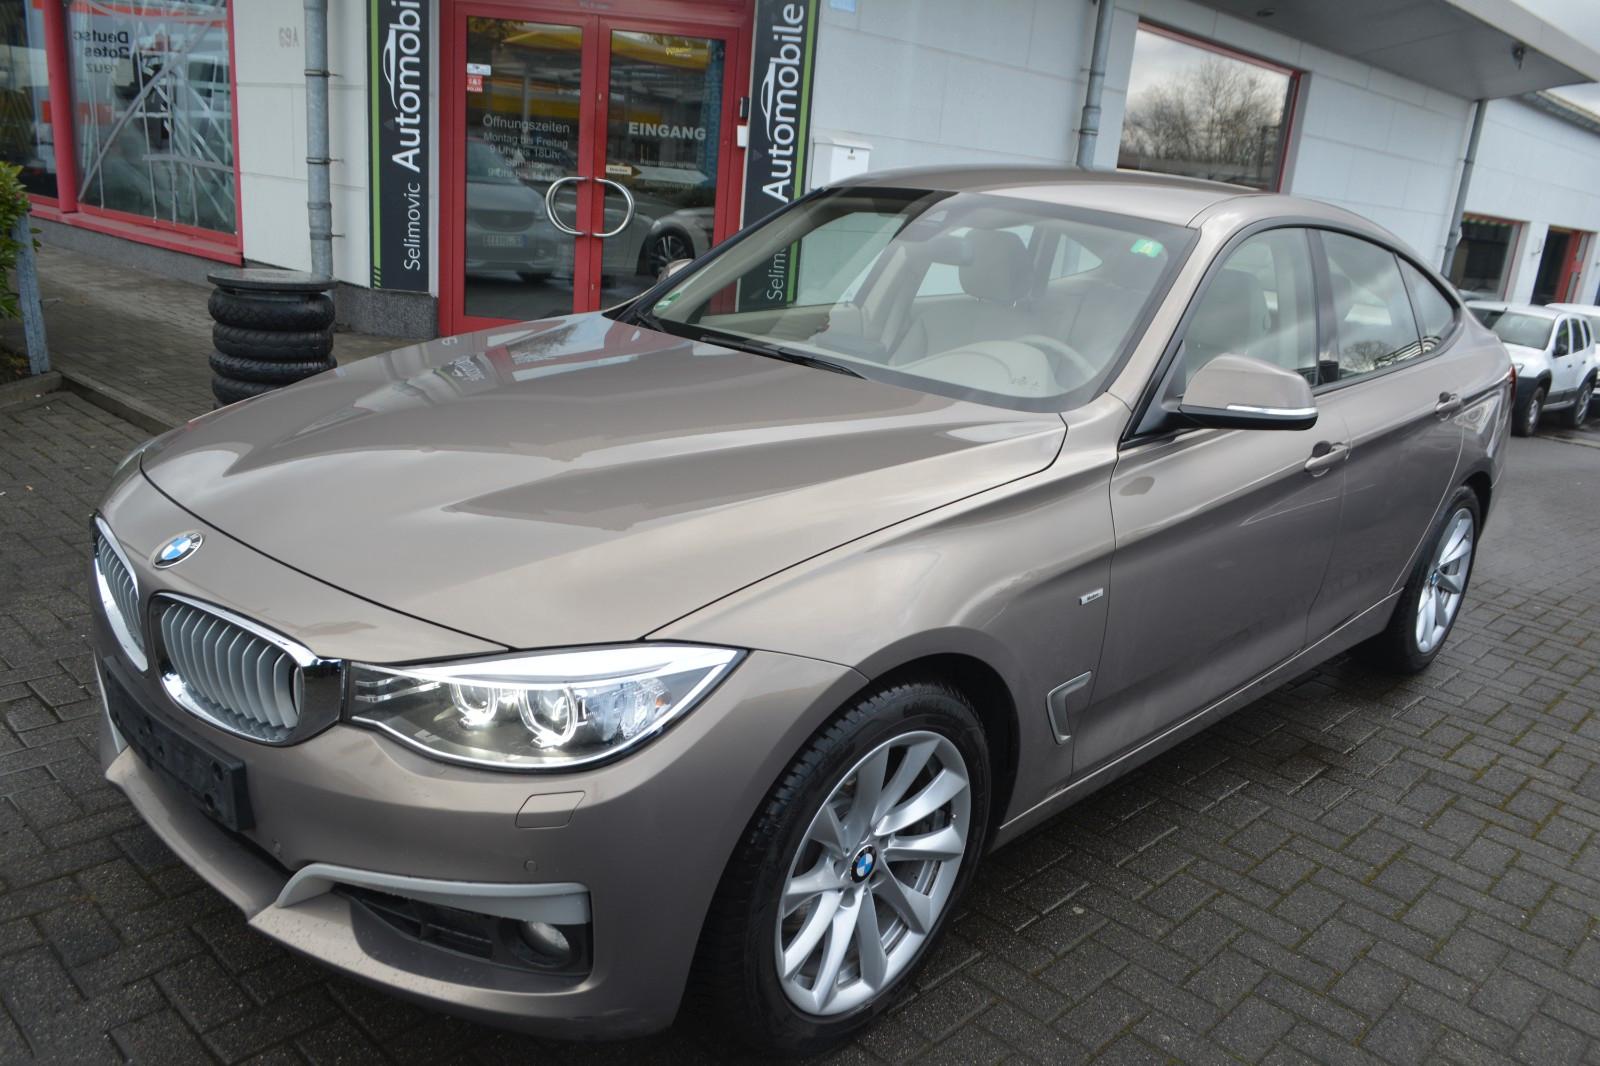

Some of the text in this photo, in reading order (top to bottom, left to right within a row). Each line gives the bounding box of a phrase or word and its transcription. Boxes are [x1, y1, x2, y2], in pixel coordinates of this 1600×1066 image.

[483, 132, 518, 146] Montag
[536, 136, 569, 150] Freitag
[628, 121, 706, 141] EINGANG
[761, 3, 805, 301] Selim Automobile
[403, 182, 421, 271] Selimovic
